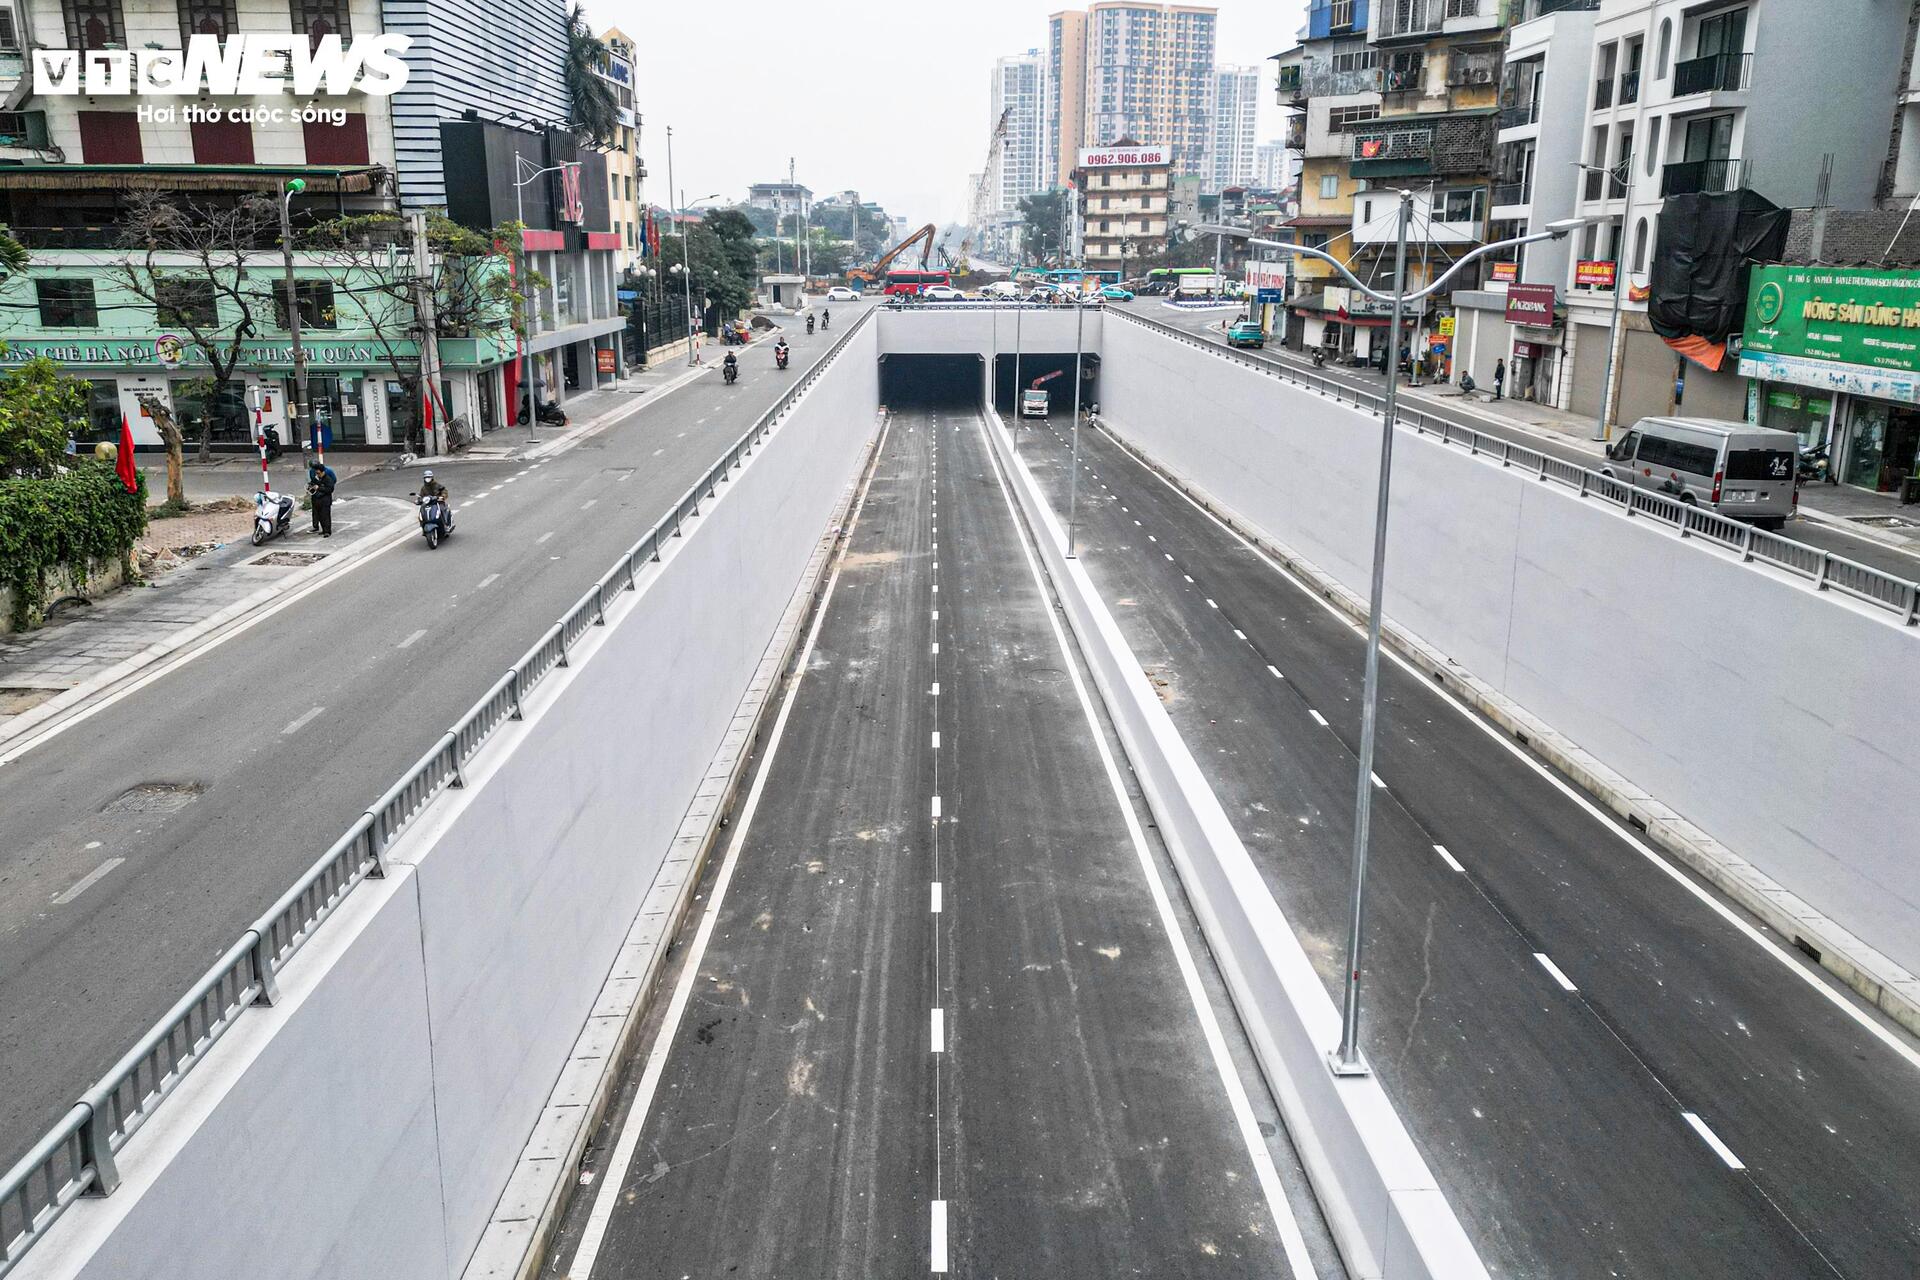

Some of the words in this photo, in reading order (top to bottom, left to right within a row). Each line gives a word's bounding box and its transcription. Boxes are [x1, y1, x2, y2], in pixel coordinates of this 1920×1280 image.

[1087, 152, 1162, 165] 0962.906.086
[1803, 296, 1837, 320] NÔNG
[1838, 299, 1864, 323] SẢN
[1864, 302, 1901, 326] DŨNG
[43, 343, 82, 361] CHÈ
[86, 343, 114, 361] HÀ
[118, 343, 151, 363] NỘI
[256, 348, 318, 364] THẠH
[322, 343, 372, 364] QUÁN
